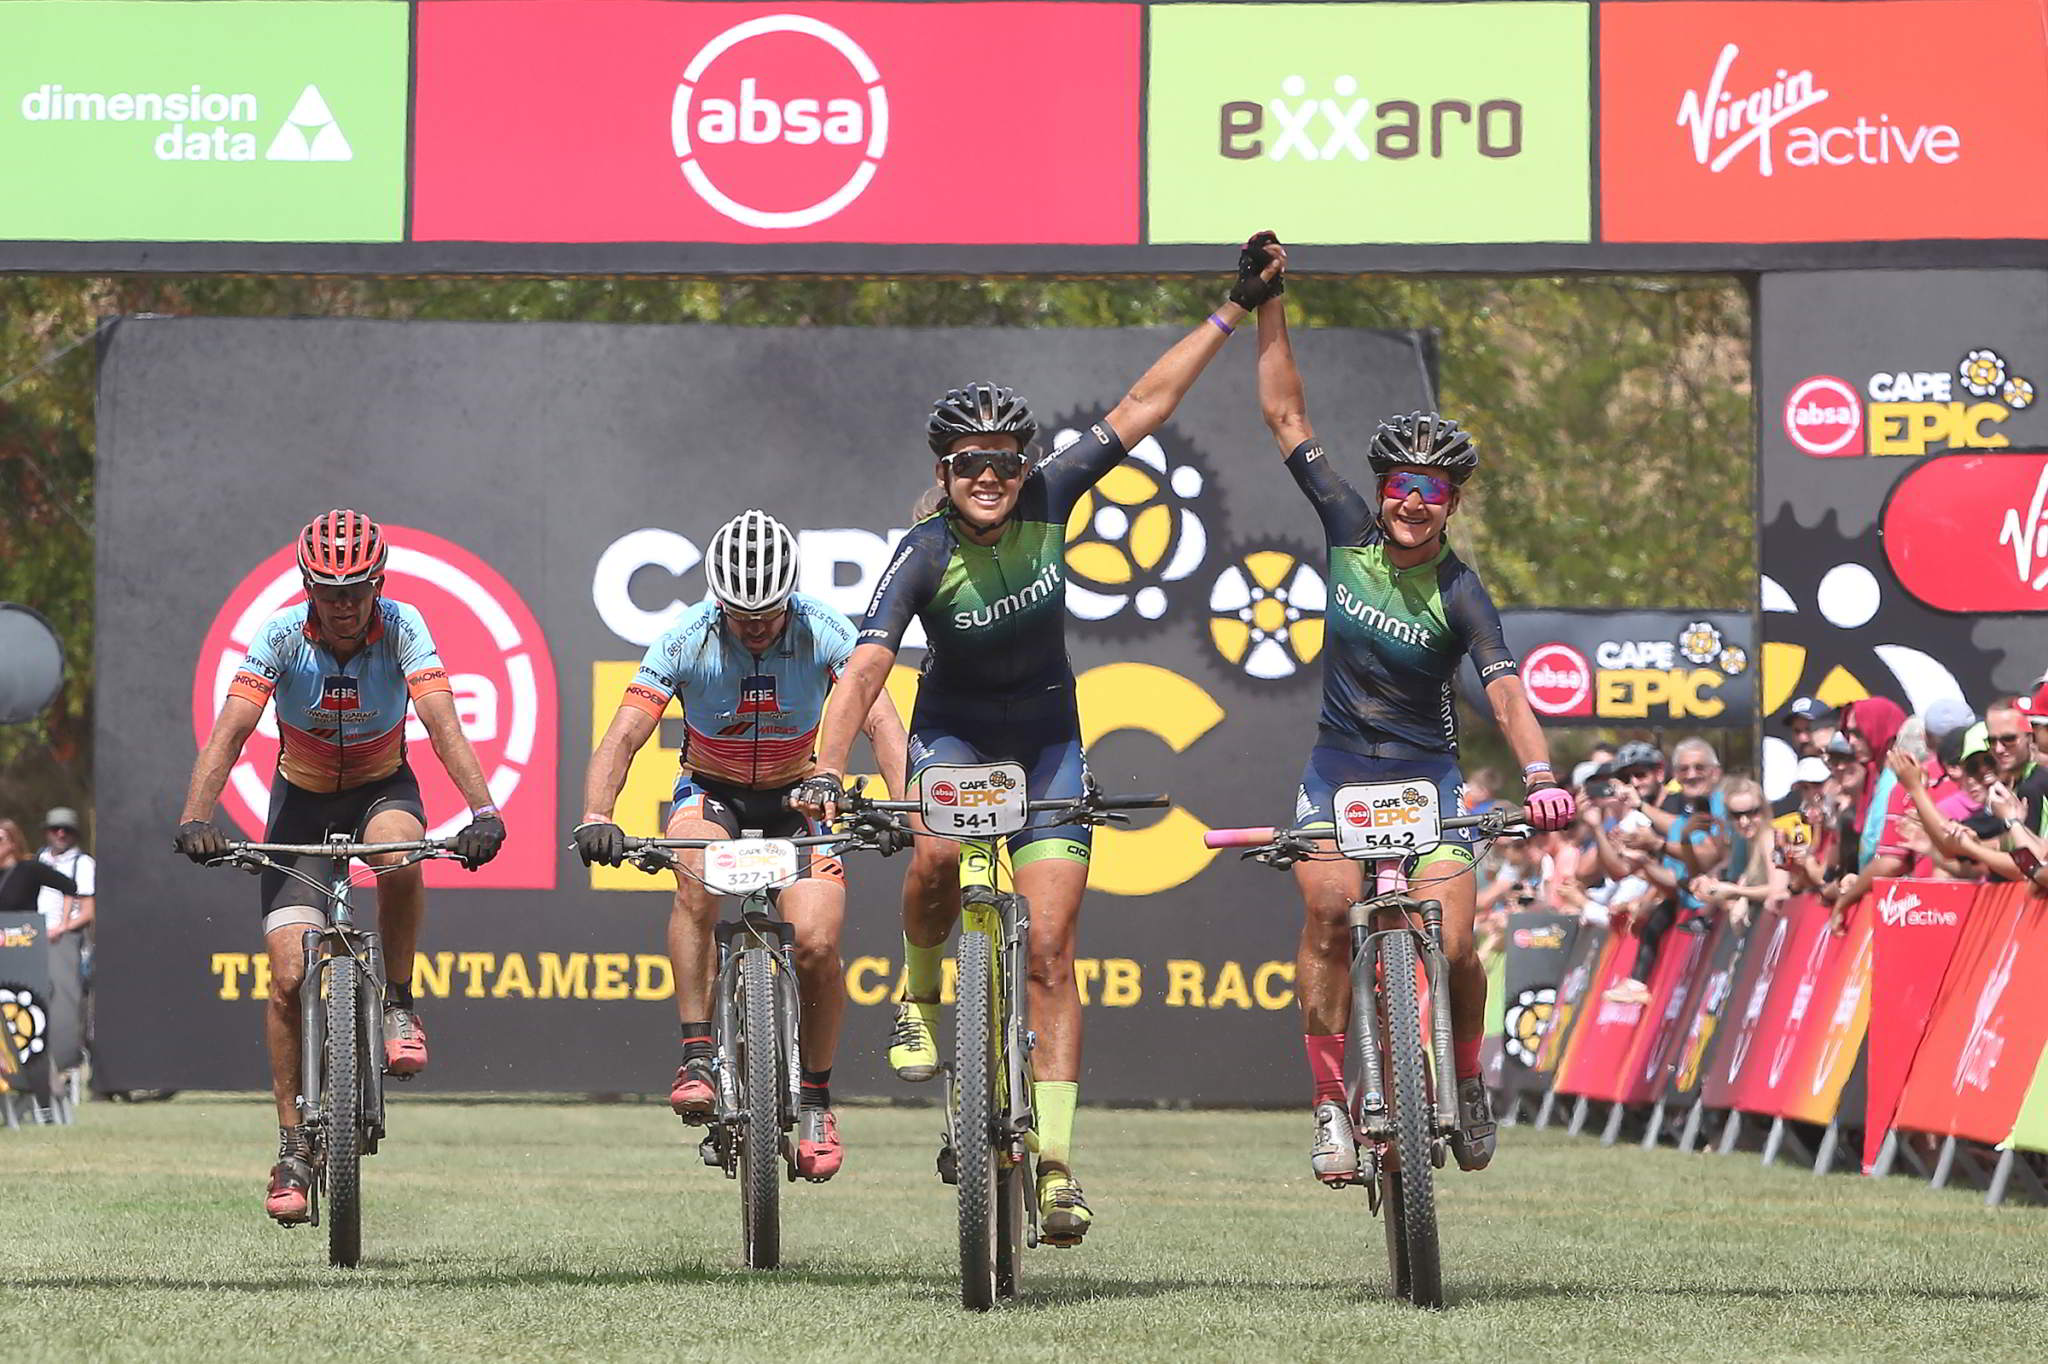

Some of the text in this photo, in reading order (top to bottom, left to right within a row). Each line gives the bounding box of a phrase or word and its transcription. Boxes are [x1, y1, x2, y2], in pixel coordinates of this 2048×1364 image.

[21, 84, 257, 122] dimension
[697, 78, 864, 145] absa
[1676, 43, 1961, 176] Virgin active
[1220, 74, 1523, 162] exxaro
[154, 123, 257, 162] data
[1868, 372, 1952, 402] CAPE
[1794, 403, 1852, 426] absa
[1868, 402, 2010, 456] EPIC
[867, 545, 914, 618] cannondale
[954, 562, 1061, 630] summit
[1335, 583, 1431, 649] summit
[1597, 641, 1675, 670] CAPE
[1530, 663, 1582, 689] absa
[325, 687, 357, 699] LGE
[743, 688, 774, 702] LGE
[1597, 668, 1726, 718] EPIC
[934, 788, 954, 798] absa
[960, 780, 988, 790] CAPE
[960, 788, 1008, 808] EPIC
[1348, 808, 1367, 819] absa
[1373, 798, 1401, 809] CAPE
[1373, 806, 1421, 828] EPIC
[953, 812, 997, 829] 54-1
[738, 848, 762, 857] CAPE
[1366, 831, 1416, 850] 54-2
[728, 871, 776, 886] 327-1
[1877, 880, 1958, 928] Virgin active
[411, 952, 677, 1001] NTAMED
[1073, 958, 1297, 1010] TB RAC
